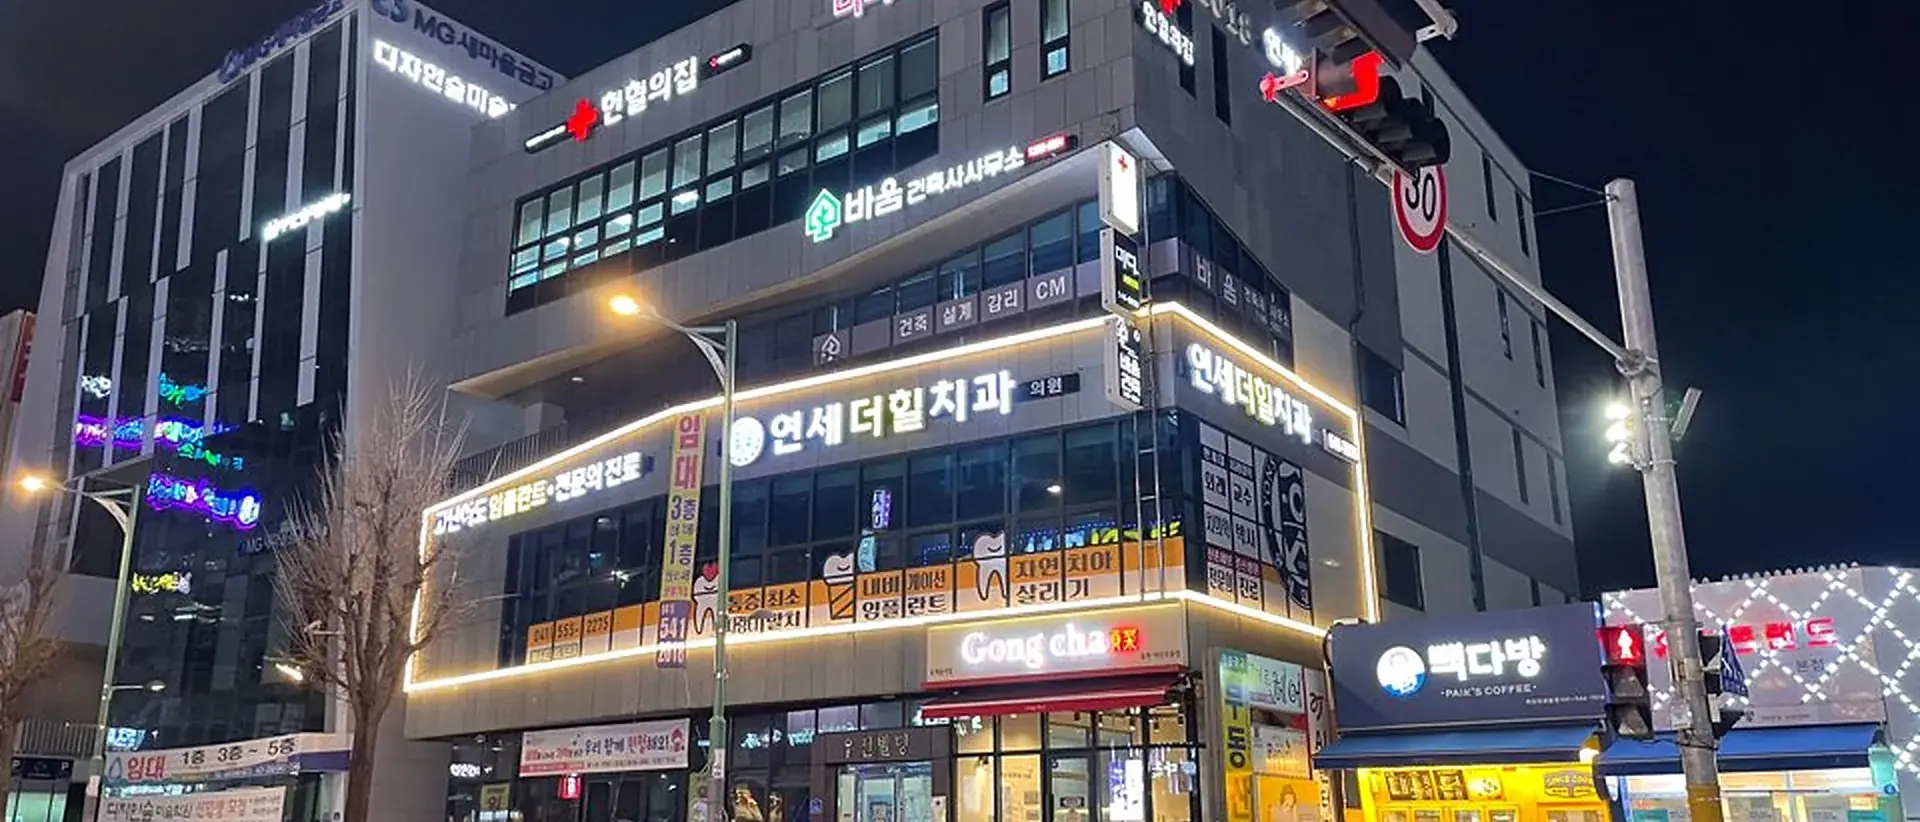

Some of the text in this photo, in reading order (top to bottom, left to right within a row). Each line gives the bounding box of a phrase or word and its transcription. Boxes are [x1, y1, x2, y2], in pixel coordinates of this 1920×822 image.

[372, 39, 518, 119] 디자인숲미술
[600, 55, 698, 127] 헌혈의집
[844, 176, 903, 224] 바움
[906, 145, 1025, 205] 건축사사무소
[1405, 166, 1437, 222] 30
[943, 301, 973, 326] 설계
[988, 288, 1019, 314] 감리
[1036, 275, 1066, 301] CM
[770, 369, 1064, 456] 연세더힐치과 의원
[1186, 342, 1313, 446] 연세더힐치과
[676, 415, 699, 490] 임대
[671, 495, 697, 522] 3층
[767, 587, 800, 607] 최소
[961, 622, 1107, 669] Gong cha
[1427, 634, 1547, 682] 빽다방
[1445, 683, 1532, 699] PAIK'S COFFEE
[61, 761, 69, 770] P
[127, 755, 166, 782] 임대
[182, 749, 206, 765] 1층
[216, 745, 243, 764] 3층
[267, 738, 297, 757] 5층
